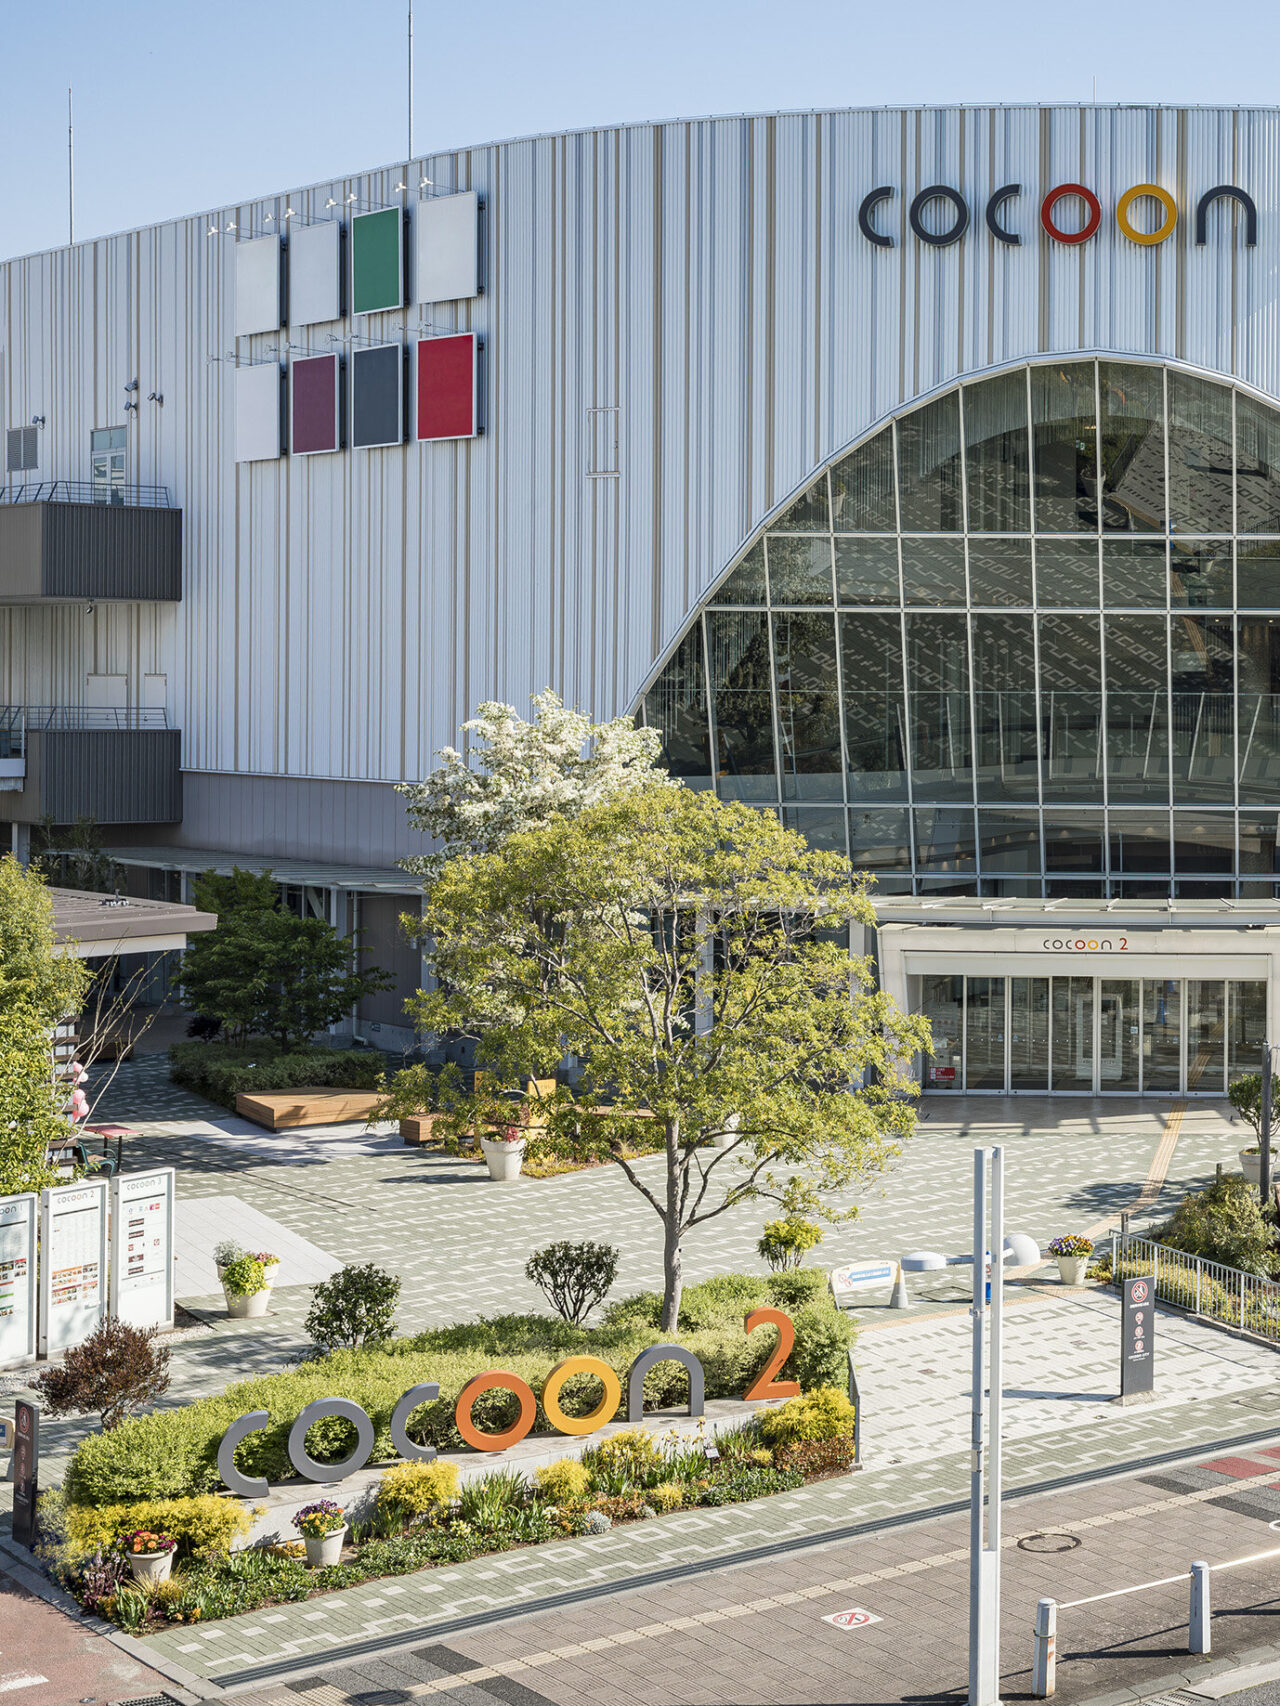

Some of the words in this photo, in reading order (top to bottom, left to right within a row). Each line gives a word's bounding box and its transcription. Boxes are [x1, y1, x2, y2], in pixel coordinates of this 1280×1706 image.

[858, 183, 1257, 248] cocoon
[1043, 939, 1112, 950] cocoon
[1119, 937, 1128, 950] 2
[127, 1178, 156, 1190] cocoon
[158, 1176, 162, 1185] 3
[58, 1193, 88, 1204] cocoon
[90, 1190, 95, 1198] 2
[217, 1343, 705, 1498] cocoon
[742, 1306, 801, 1401] 2
